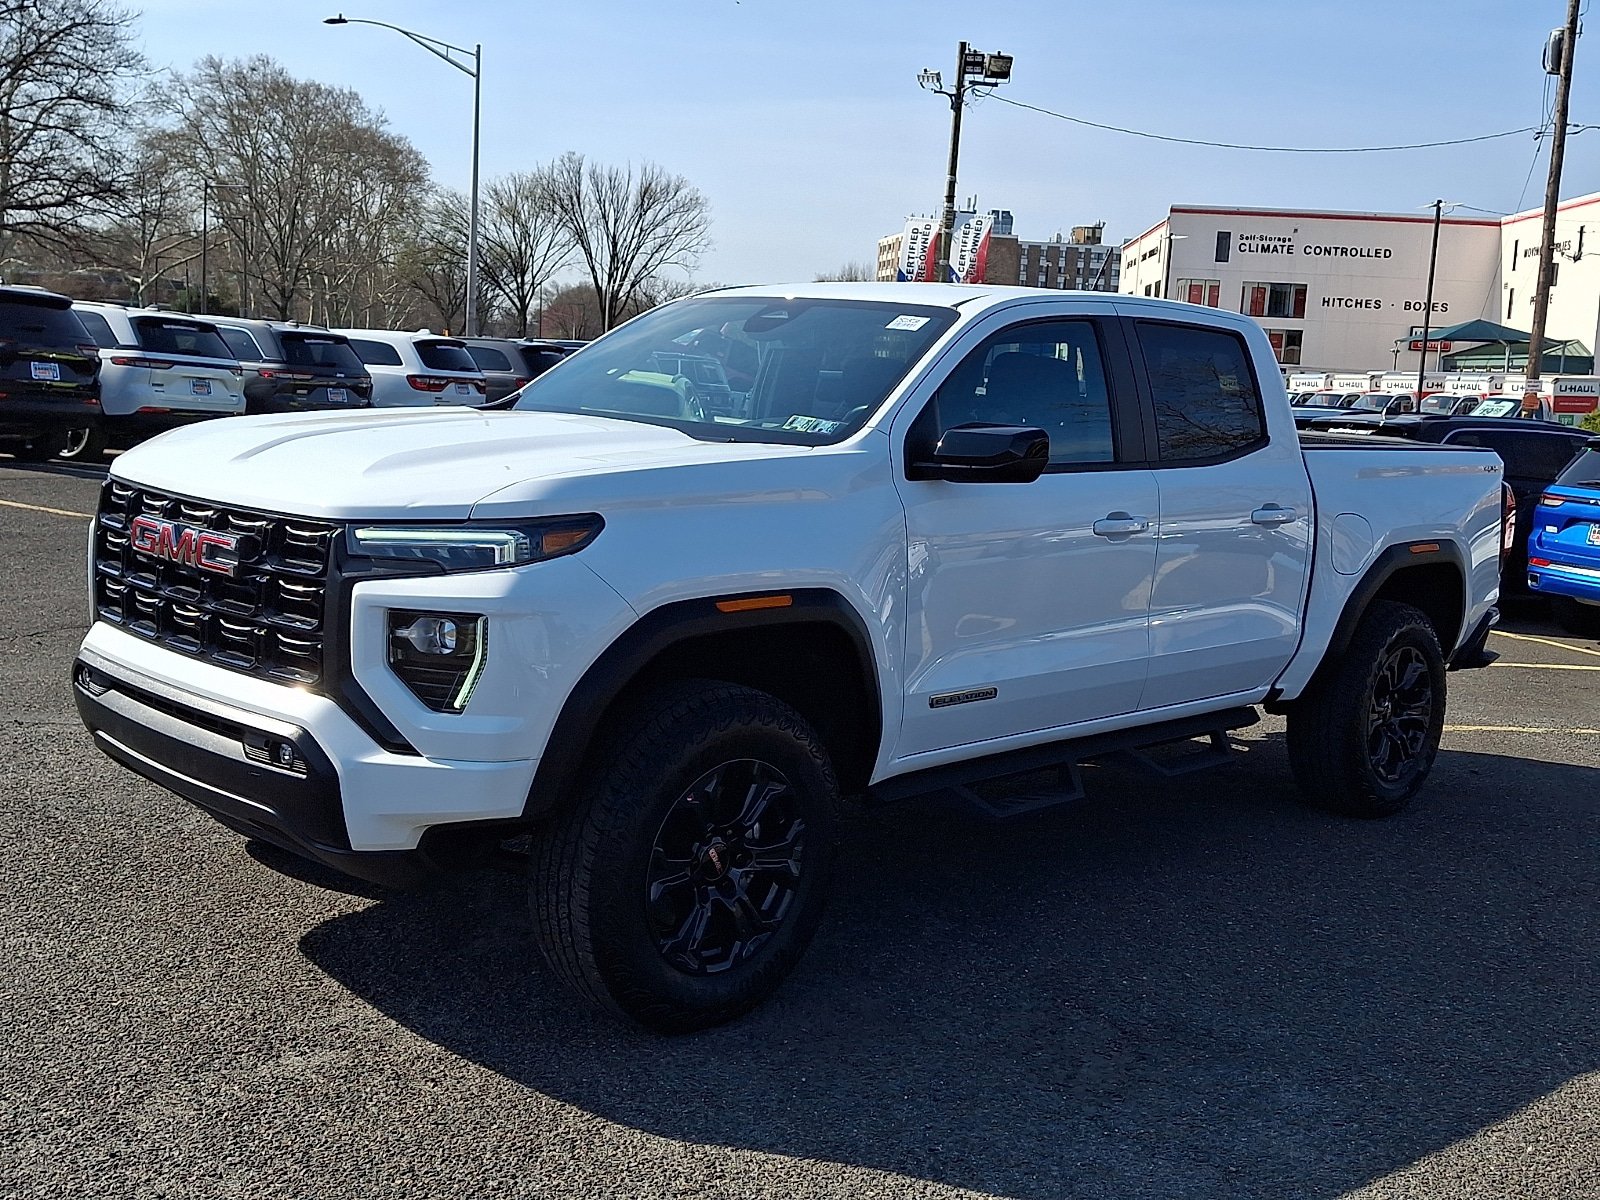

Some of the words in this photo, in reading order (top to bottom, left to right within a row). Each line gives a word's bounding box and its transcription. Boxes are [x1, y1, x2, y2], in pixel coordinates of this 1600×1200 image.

[1239, 233, 1292, 243] Self-Storage
[906, 228, 919, 282] CERTIFIED
[958, 223, 971, 273] CERTIFIED
[968, 219, 984, 276] PRE-OWNED
[1238, 243, 1295, 255] CLIMATE
[1303, 245, 1392, 259] CONTROLLED
[1322, 297, 1382, 310] HITCHES
[1559, 384, 1596, 393] U-HAUL
[131, 514, 239, 577] GMC
[934, 690, 994, 707] ELEVATION
